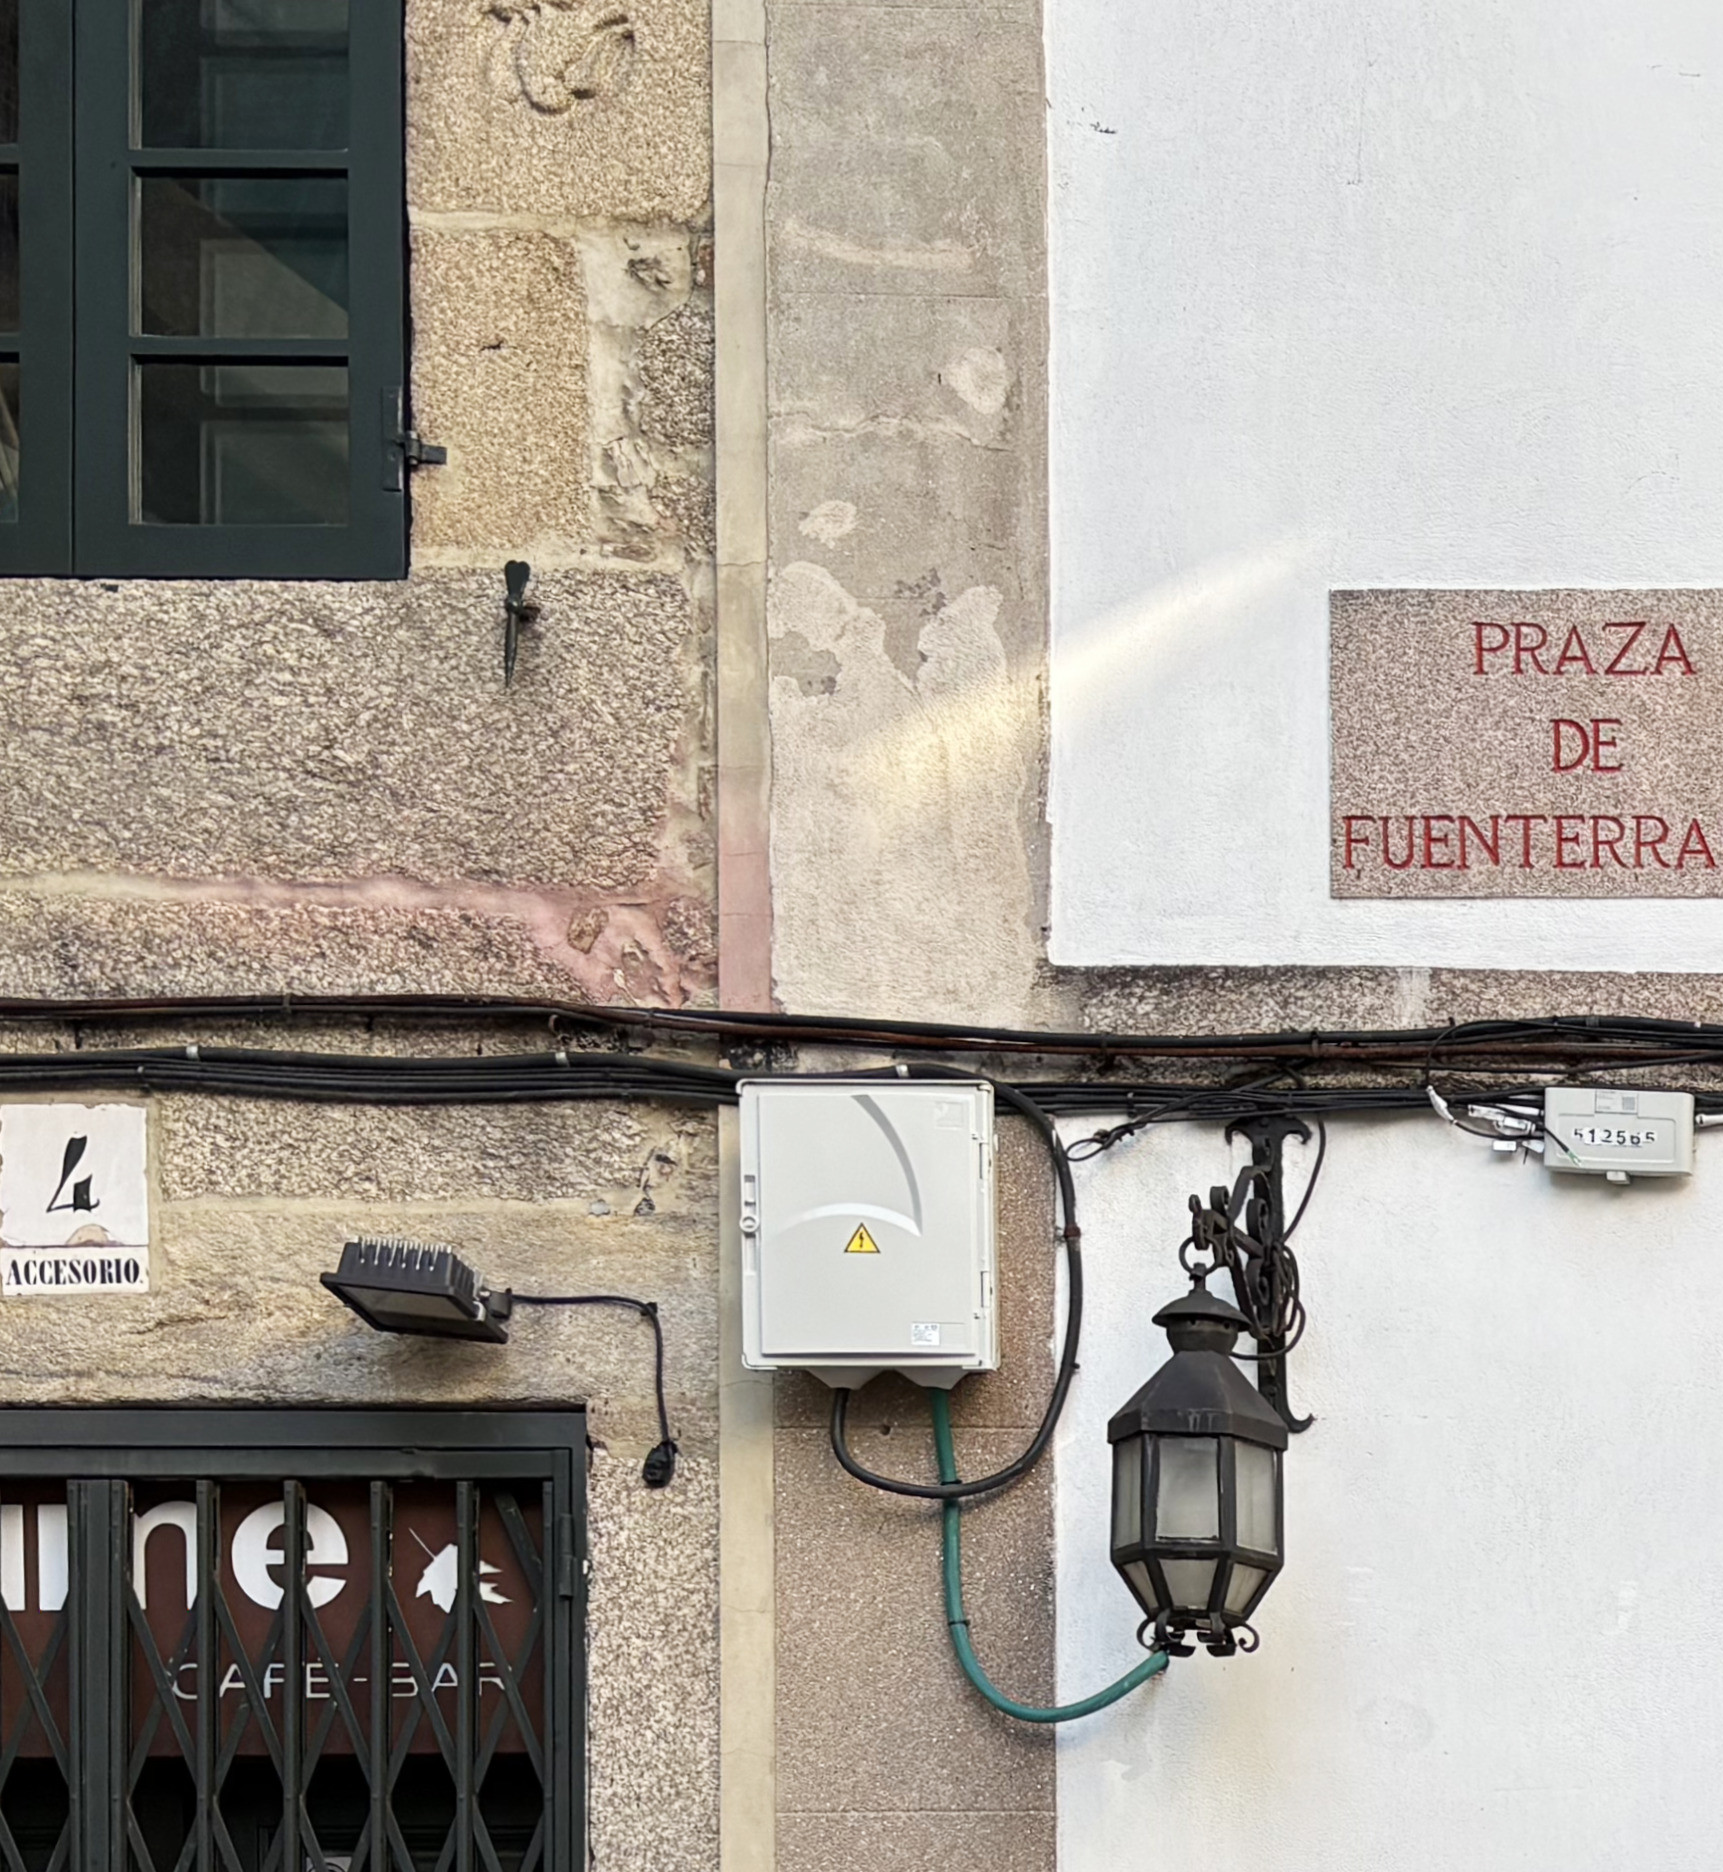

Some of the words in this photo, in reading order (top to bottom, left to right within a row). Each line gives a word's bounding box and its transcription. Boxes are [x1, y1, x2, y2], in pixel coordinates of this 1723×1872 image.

[1471, 620, 1697, 676] PRAZA
[1550, 717, 1625, 773] DE
[45, 1134, 101, 1213] 4
